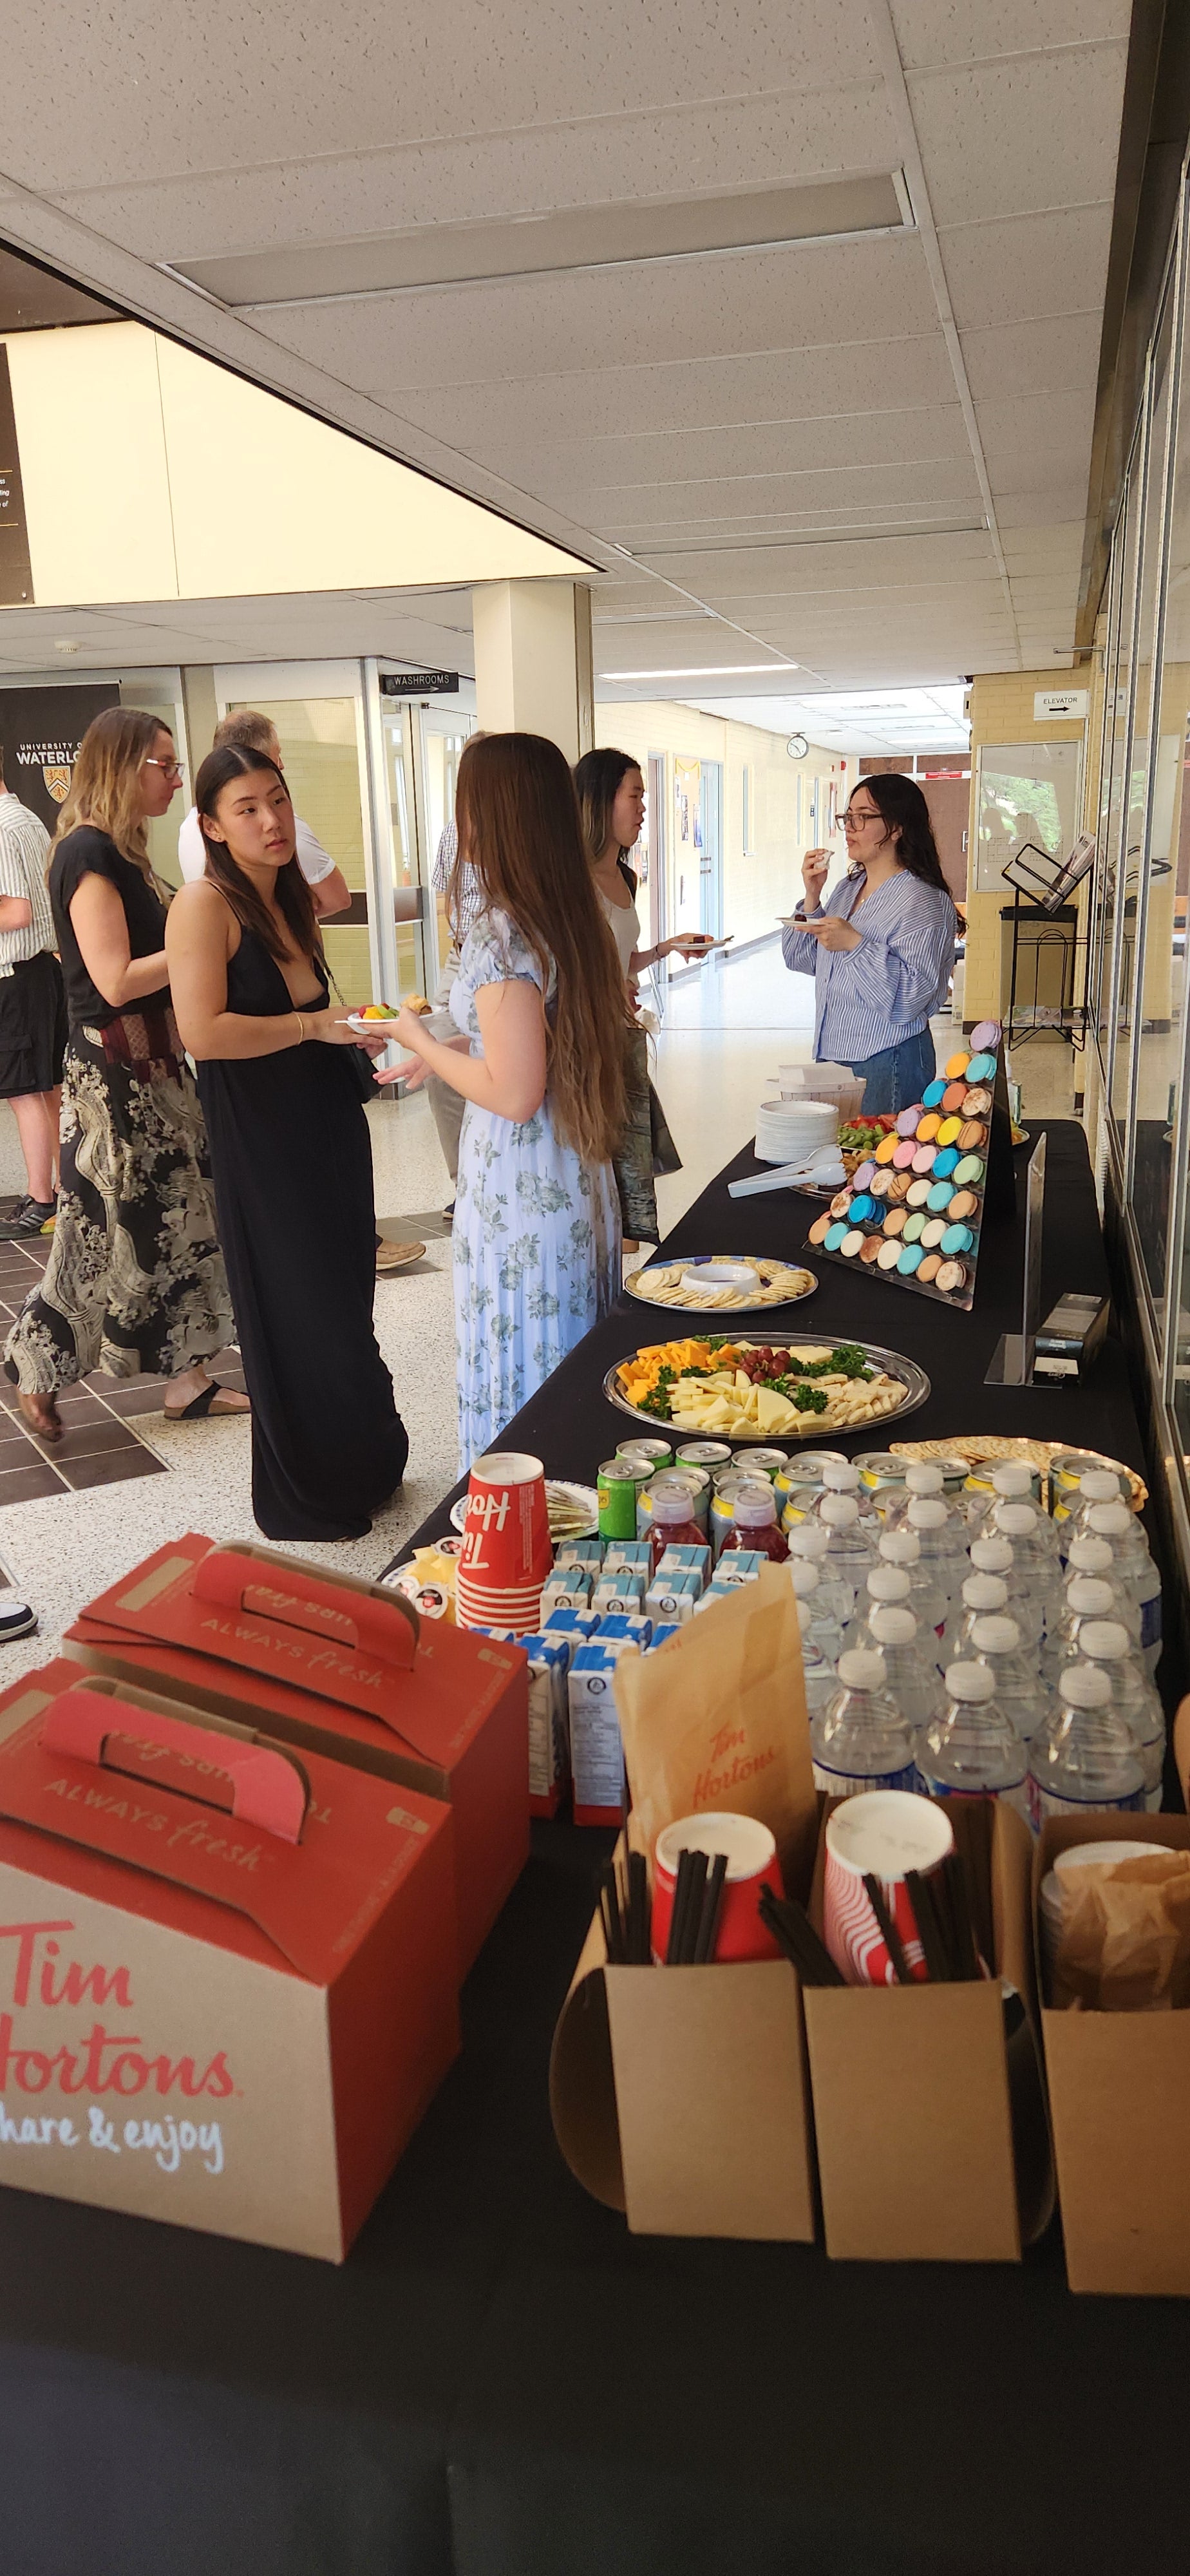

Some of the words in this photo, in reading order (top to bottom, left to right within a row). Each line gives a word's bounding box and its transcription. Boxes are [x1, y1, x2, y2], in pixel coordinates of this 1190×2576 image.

[394, 675, 449, 686] WASHROOMS
[15, 751, 82, 765] WATERLO
[20, 743, 73, 751] UNIVERSITY
[200, 1618, 305, 1658] ALWAYS
[307, 1650, 382, 1689] fresh
[710, 1720, 744, 1763] Tim
[692, 1745, 777, 1810] Hortons
[44, 1778, 169, 1832] ALWAYS
[165, 1819, 260, 1871] fresh
[0, 1920, 134, 2007] Tim
[0, 2101, 80, 2146] hare
[88, 2104, 121, 2154] &
[124, 2114, 225, 2174] enjoy
